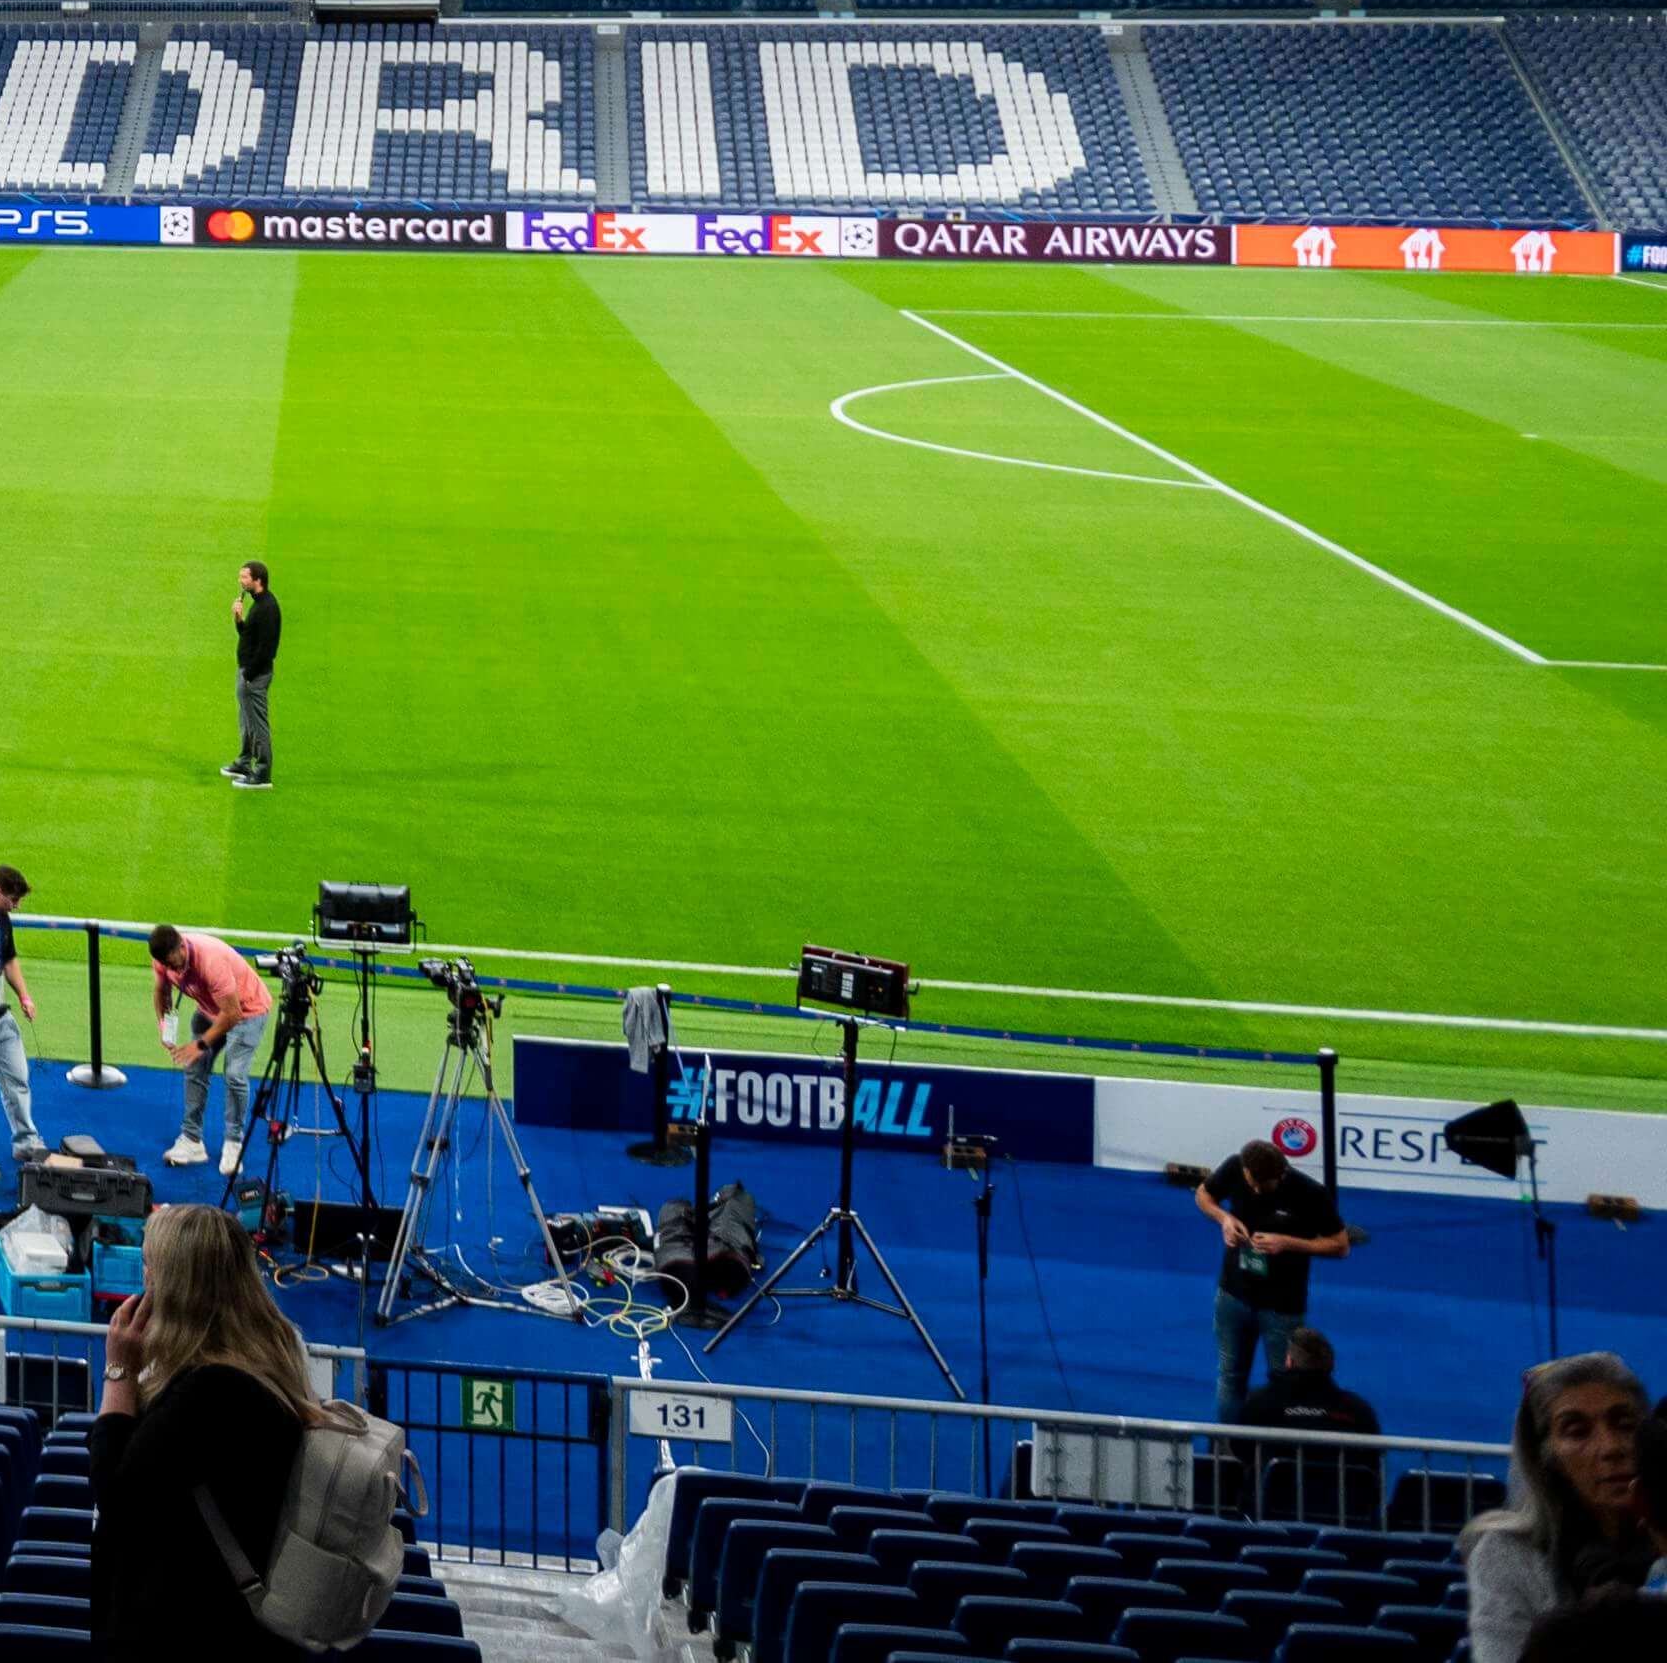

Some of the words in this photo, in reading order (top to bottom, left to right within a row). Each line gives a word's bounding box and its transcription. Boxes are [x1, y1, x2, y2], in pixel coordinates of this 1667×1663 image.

[264, 214, 492, 243] mastercard
[523, 212, 646, 253] FedEx
[696, 214, 823, 255] FedEx
[894, 223, 1027, 257] QATAR
[1044, 226, 1217, 257] AIRWAYS
[667, 1066, 932, 1136] #FOOTBALL
[656, 1403, 705, 1429] 131
